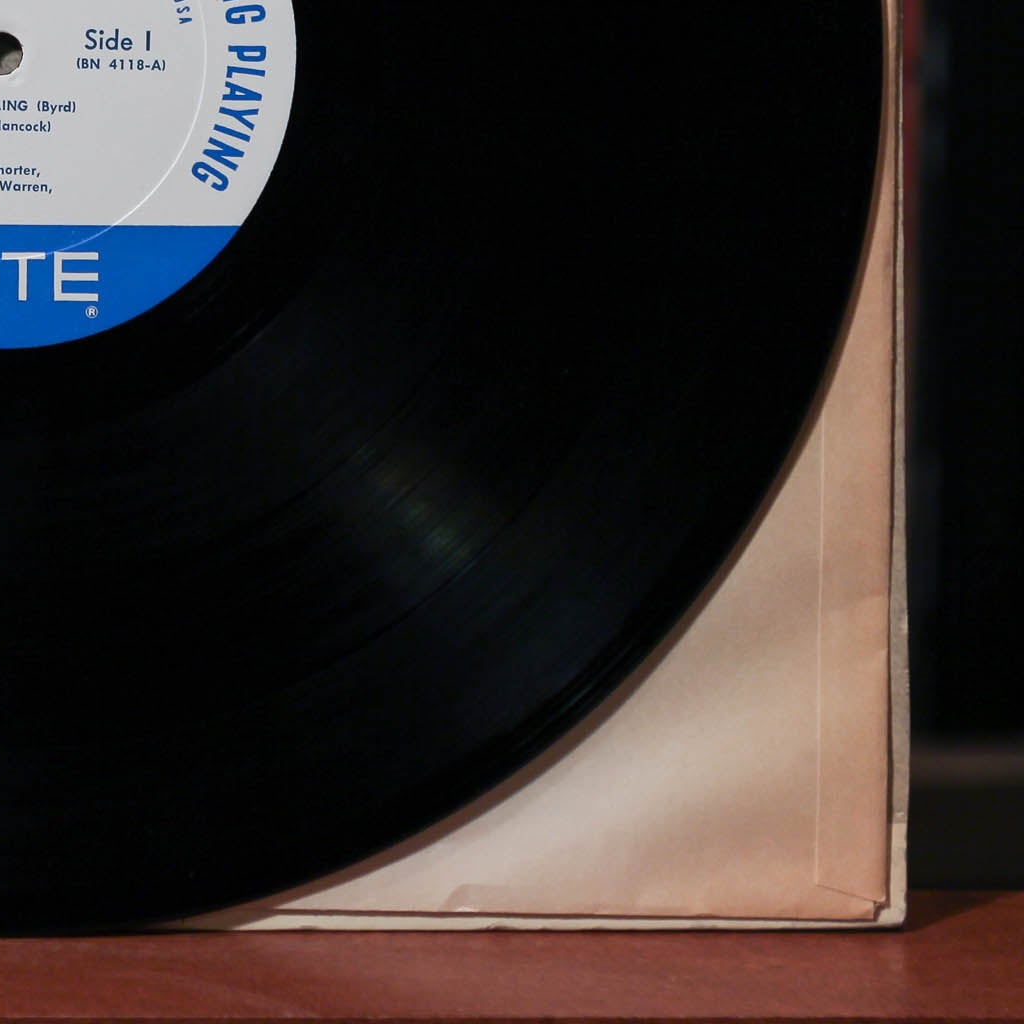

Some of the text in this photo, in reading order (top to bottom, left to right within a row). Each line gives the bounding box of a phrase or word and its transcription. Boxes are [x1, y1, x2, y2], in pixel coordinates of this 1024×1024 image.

[84, 28, 133, 51] Side
[76, 57, 166, 72] (BN 4118-A)
[37, 100, 76, 115] (Byrd)
[191, 44, 268, 194] PLAYING
[0, 180, 53, 194] Warren,
